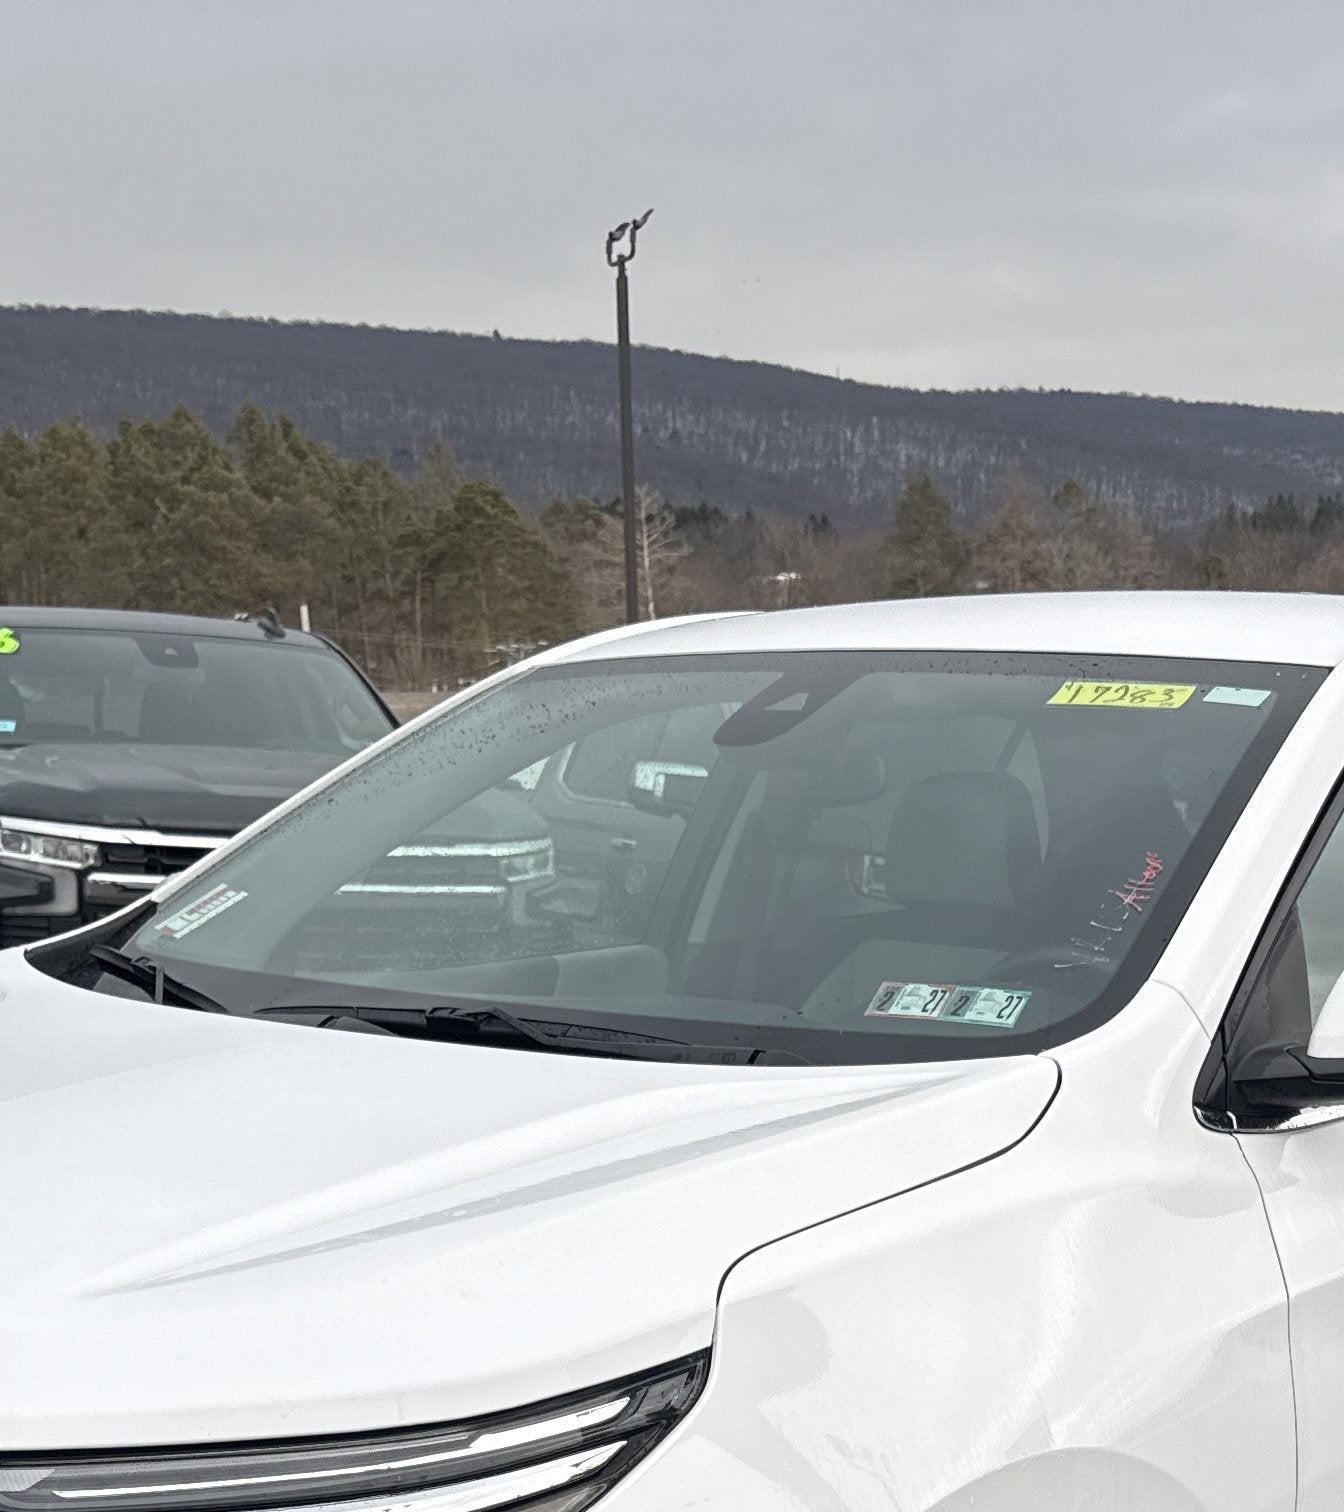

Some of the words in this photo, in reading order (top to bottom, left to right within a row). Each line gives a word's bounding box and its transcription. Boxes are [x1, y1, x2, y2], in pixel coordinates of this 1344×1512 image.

[875, 990, 896, 1012] 2
[921, 989, 948, 1015] 27
[950, 995, 971, 1017] 2
[996, 995, 1023, 1021] 27
